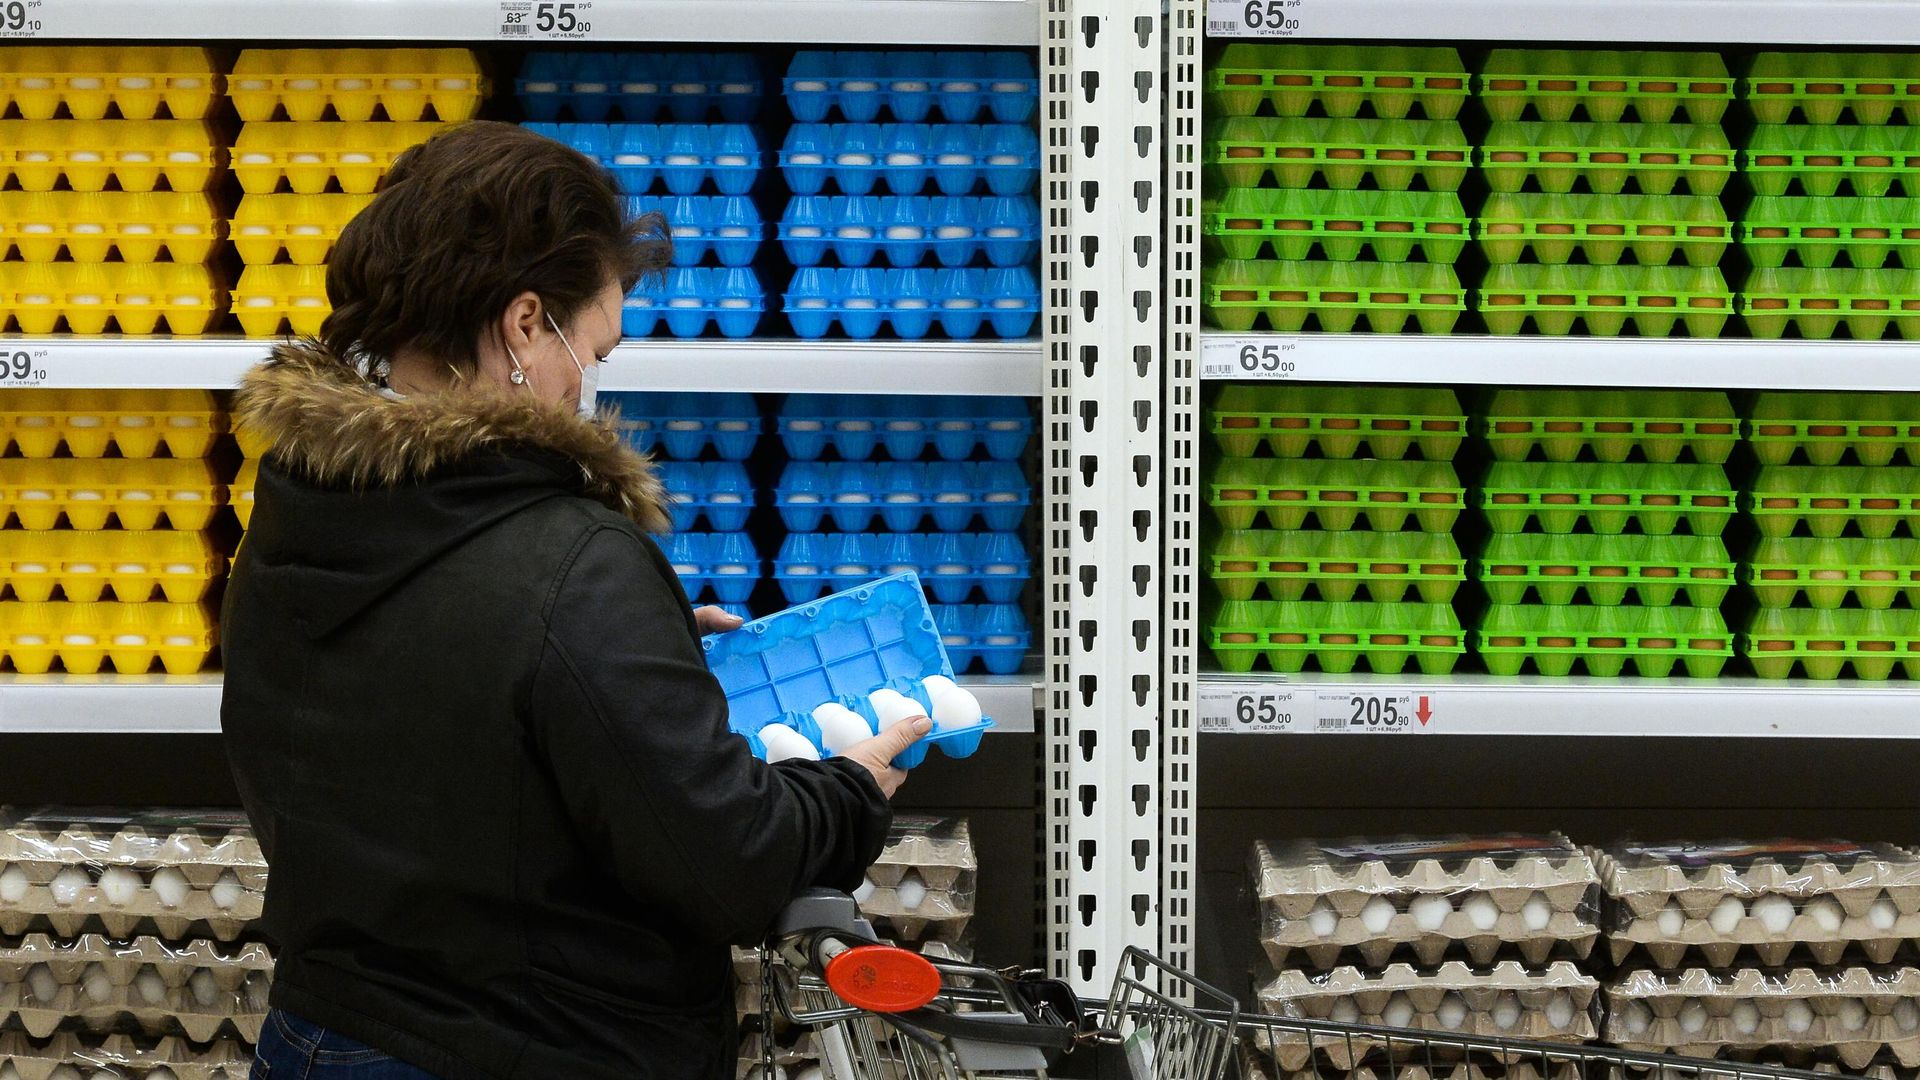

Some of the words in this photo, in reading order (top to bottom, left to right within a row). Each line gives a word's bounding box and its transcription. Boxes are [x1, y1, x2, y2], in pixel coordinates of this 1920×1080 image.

[0, 1, 25, 30] 9
[536, 3, 576, 32] 55
[1244, 1, 1284, 29] 65
[28, 20, 41, 30] 10
[577, 22, 591, 32] 00
[1285, 20, 1299, 29] 00
[34, 350, 48, 358] руб
[1240, 345, 1280, 371] 65
[1281, 362, 1295, 372] 00
[33, 369, 47, 380] 10
[1278, 693, 1292, 701] руб
[1399, 695, 1410, 703] руб
[1236, 695, 1276, 724] 65
[1350, 696, 1398, 725] 205
[1277, 713, 1291, 724] 00
[1397, 716, 1409, 726] 90
